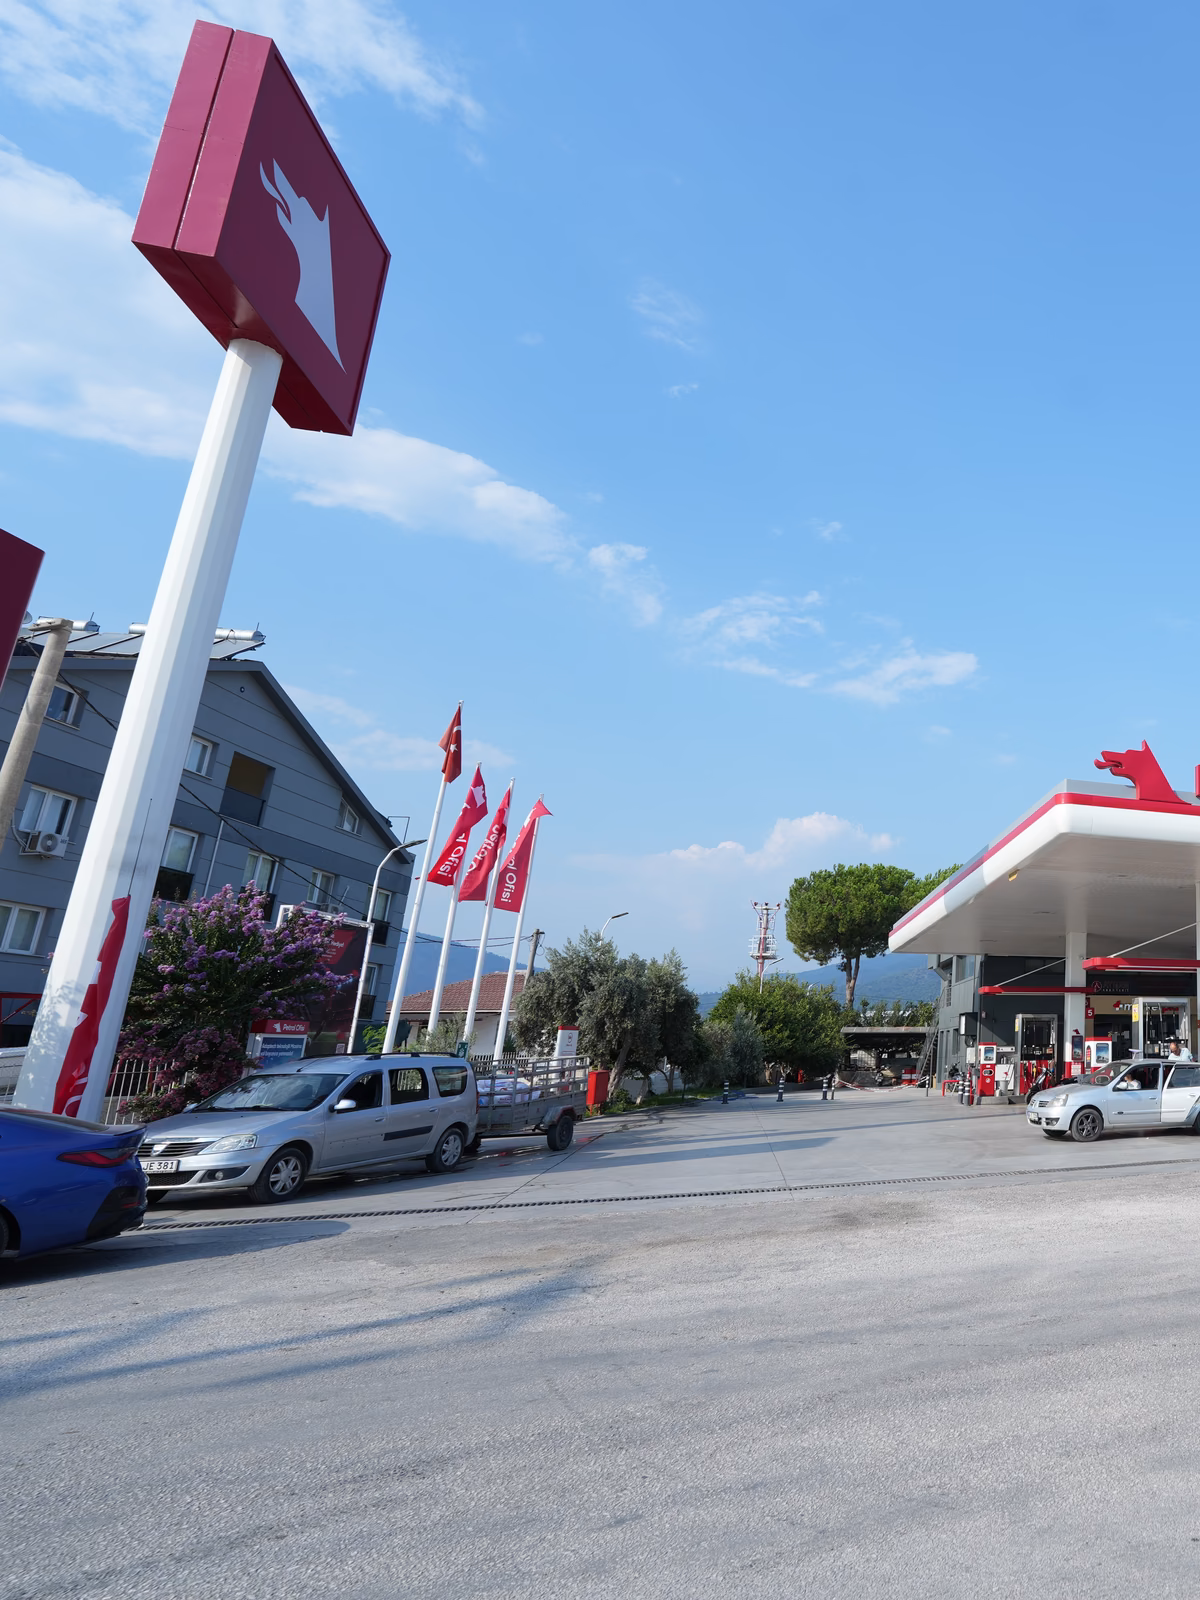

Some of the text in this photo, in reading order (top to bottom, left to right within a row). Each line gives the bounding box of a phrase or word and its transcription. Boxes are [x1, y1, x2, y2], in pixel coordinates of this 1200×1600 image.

[437, 846, 465, 877] Ofisi
[500, 872, 517, 903] Ofisi
[157, 1162, 174, 1170] 381
